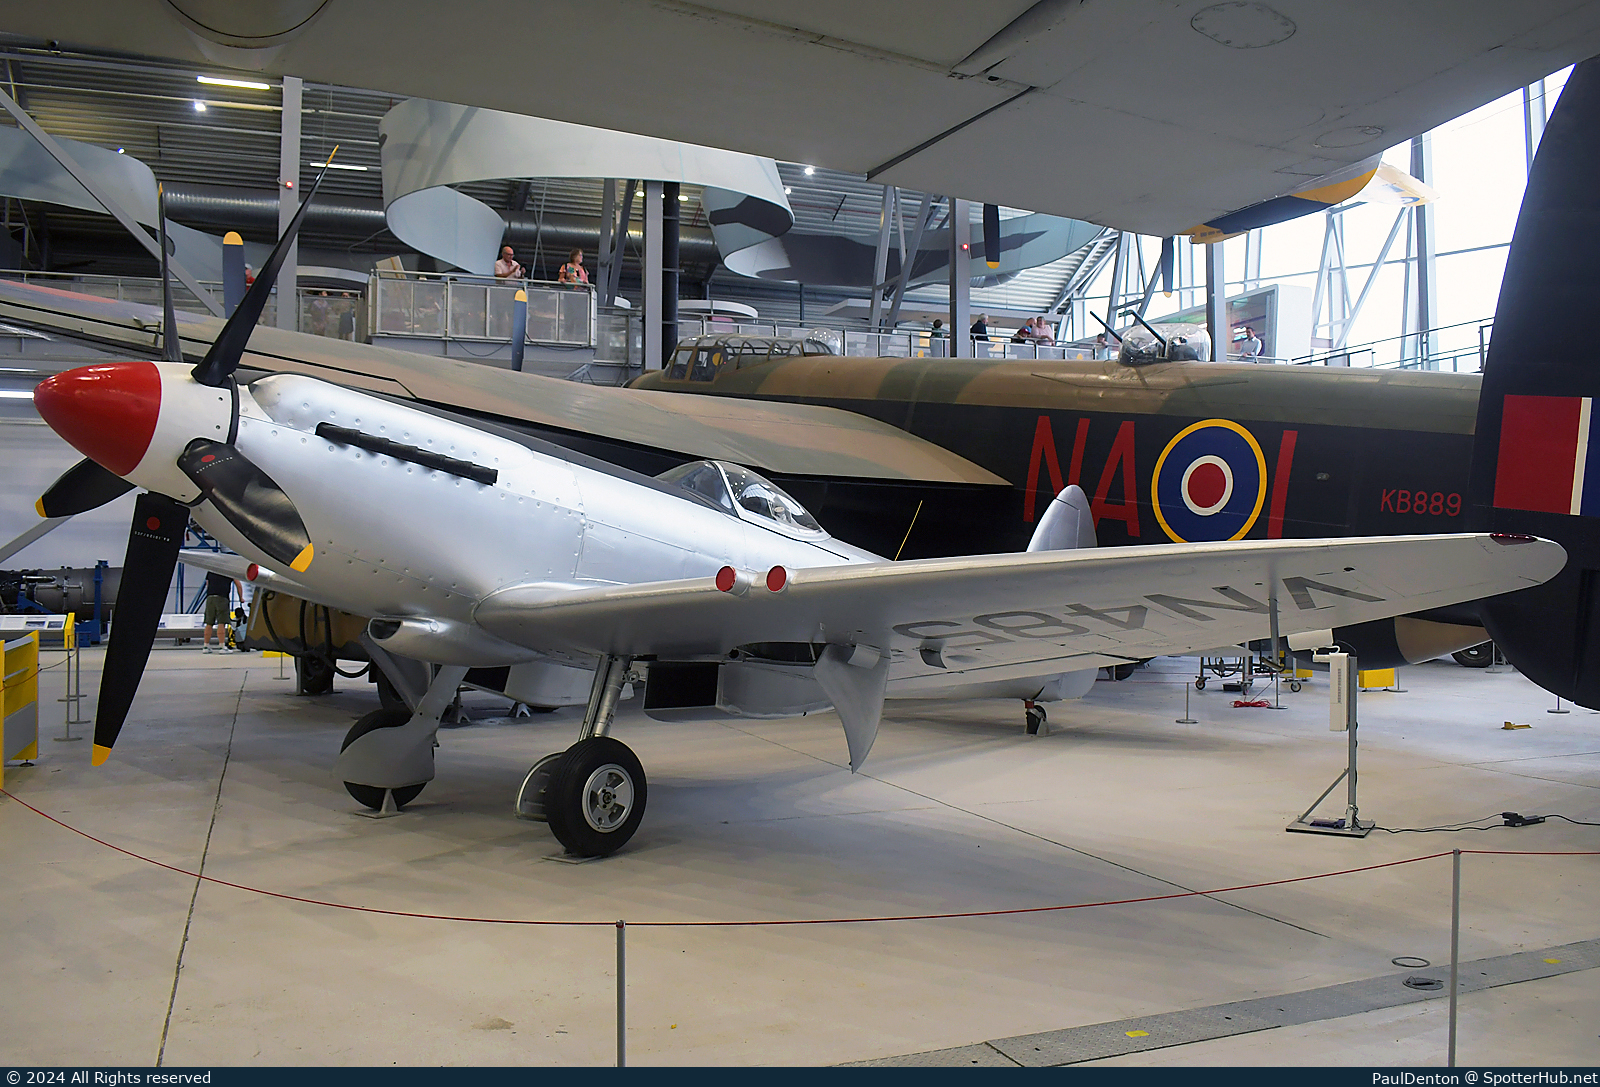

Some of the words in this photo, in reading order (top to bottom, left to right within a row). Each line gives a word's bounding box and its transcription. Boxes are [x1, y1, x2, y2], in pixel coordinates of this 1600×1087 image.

[1023, 415, 1141, 538] NA
[1380, 488, 1462, 517] KB889
[892, 576, 1387, 648] VN485
